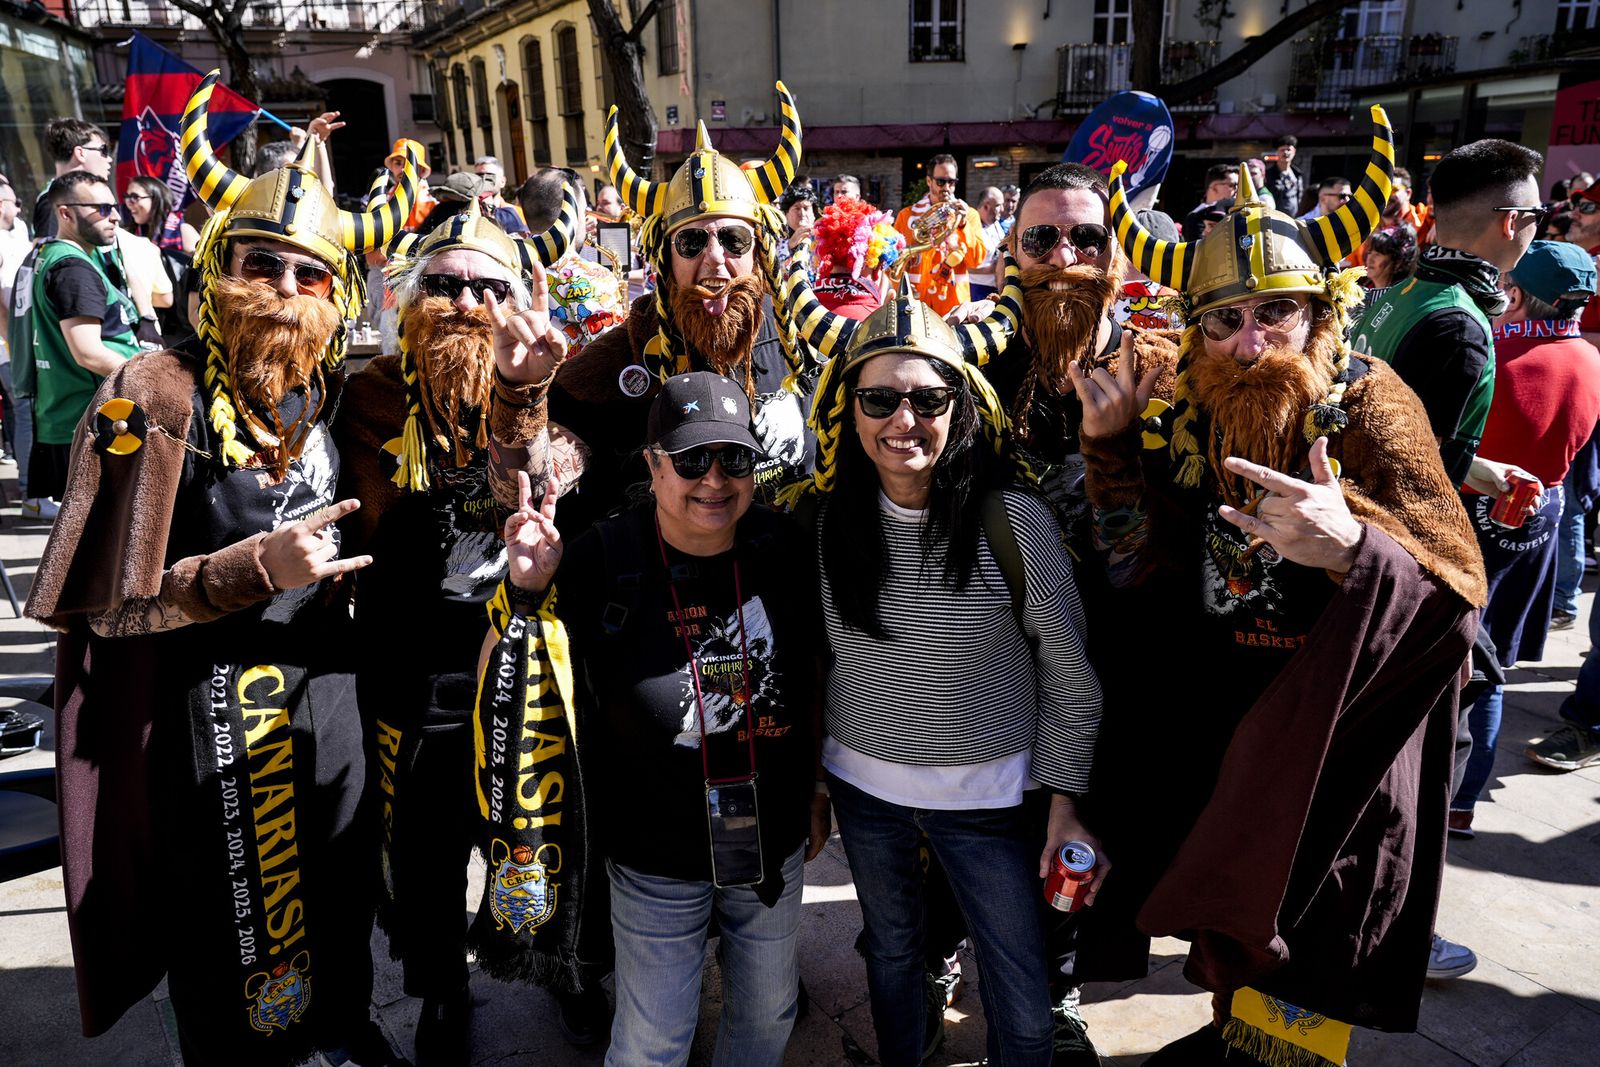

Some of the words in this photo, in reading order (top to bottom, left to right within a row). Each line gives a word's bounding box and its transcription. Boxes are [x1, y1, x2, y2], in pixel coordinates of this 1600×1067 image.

[1113, 115, 1144, 128] volver
[1145, 123, 1153, 131] a
[567, 286, 597, 299] ZAP!
[283, 496, 328, 519] VIKINGOS
[1499, 532, 1551, 552] GASTEIZ
[1234, 630, 1308, 649] BASKET
[1256, 617, 1278, 632] EL
[209, 664, 230, 717] 2021,
[492, 652, 517, 707] 2024,
[492, 716, 509, 767] 2025,
[759, 716, 776, 728] EL
[213, 722, 235, 773] 2022,
[221, 776, 240, 826] 2023,
[237, 664, 306, 956] CANARIAS!
[491, 776, 505, 824] 2026
[226, 828, 246, 875] 2024,
[232, 877, 252, 923] 2025,
[238, 926, 257, 965] 2026
